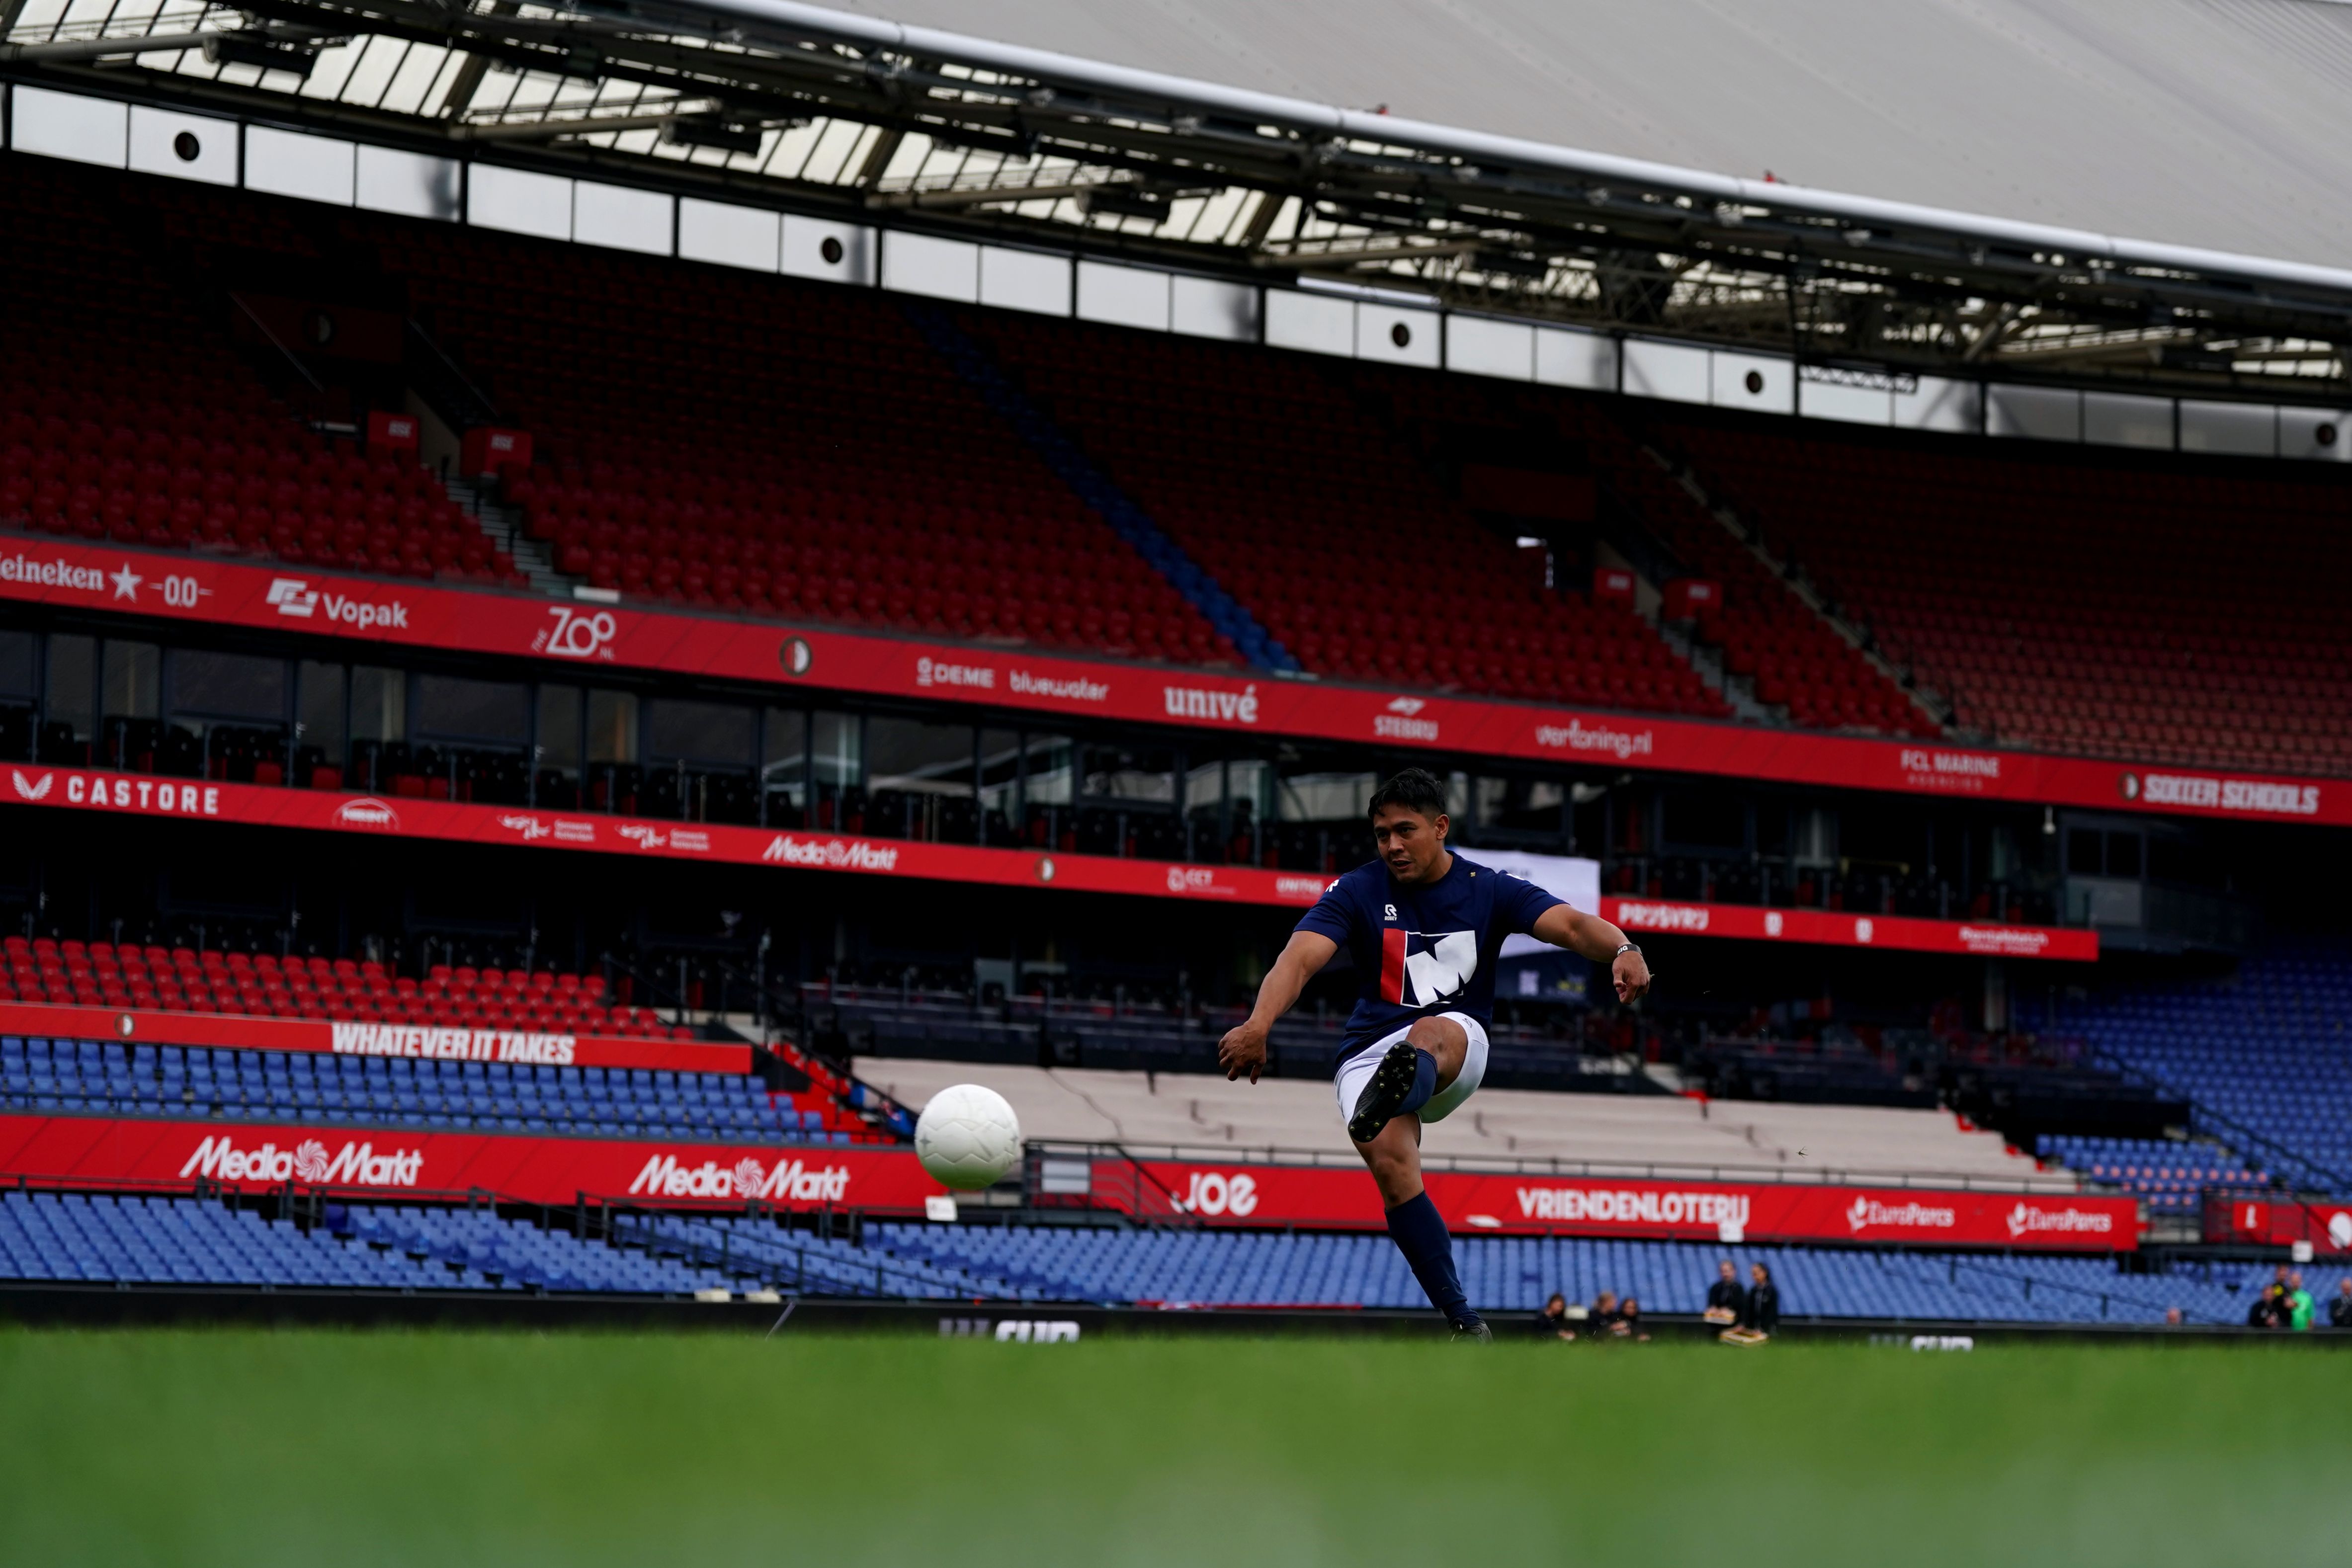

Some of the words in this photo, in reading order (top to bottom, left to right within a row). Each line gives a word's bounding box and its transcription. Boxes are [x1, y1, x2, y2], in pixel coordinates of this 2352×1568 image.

[0, 551, 104, 591] eineken
[323, 592, 408, 630] Vopak
[933, 663, 995, 689] DEME
[1010, 669, 1109, 701] bluewater
[1164, 684, 1259, 723] univé
[1933, 752, 1999, 778] MARINE
[67, 775, 219, 815] CASTORE
[2143, 773, 2220, 808] SOCCER
[2220, 780, 2320, 815] SCHOOLS
[762, 835, 826, 865] Media
[840, 841, 898, 871] Markt
[332, 1022, 470, 1060] WHATEVER
[470, 1029, 497, 1061] IT
[497, 1031, 577, 1066] TAKES
[179, 1136, 293, 1181] Media
[322, 1141, 423, 1186] Markt
[628, 1154, 733, 1198] Media
[758, 1158, 850, 1201] Markt
